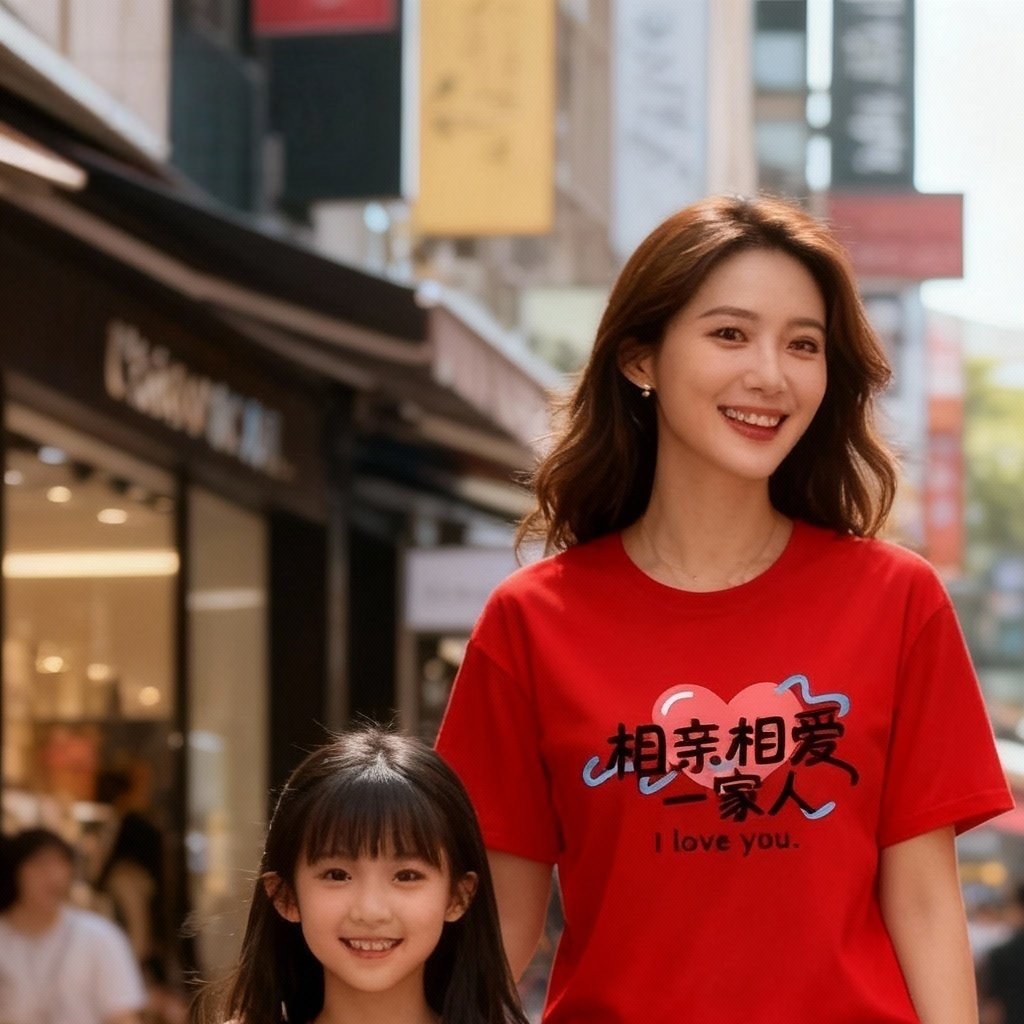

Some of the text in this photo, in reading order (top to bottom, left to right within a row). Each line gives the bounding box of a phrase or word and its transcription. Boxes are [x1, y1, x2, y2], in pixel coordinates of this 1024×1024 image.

[607, 707, 859, 787] 相亲相爱
[663, 769, 817, 823] 一家人
[654, 828, 800, 858] I love you.
